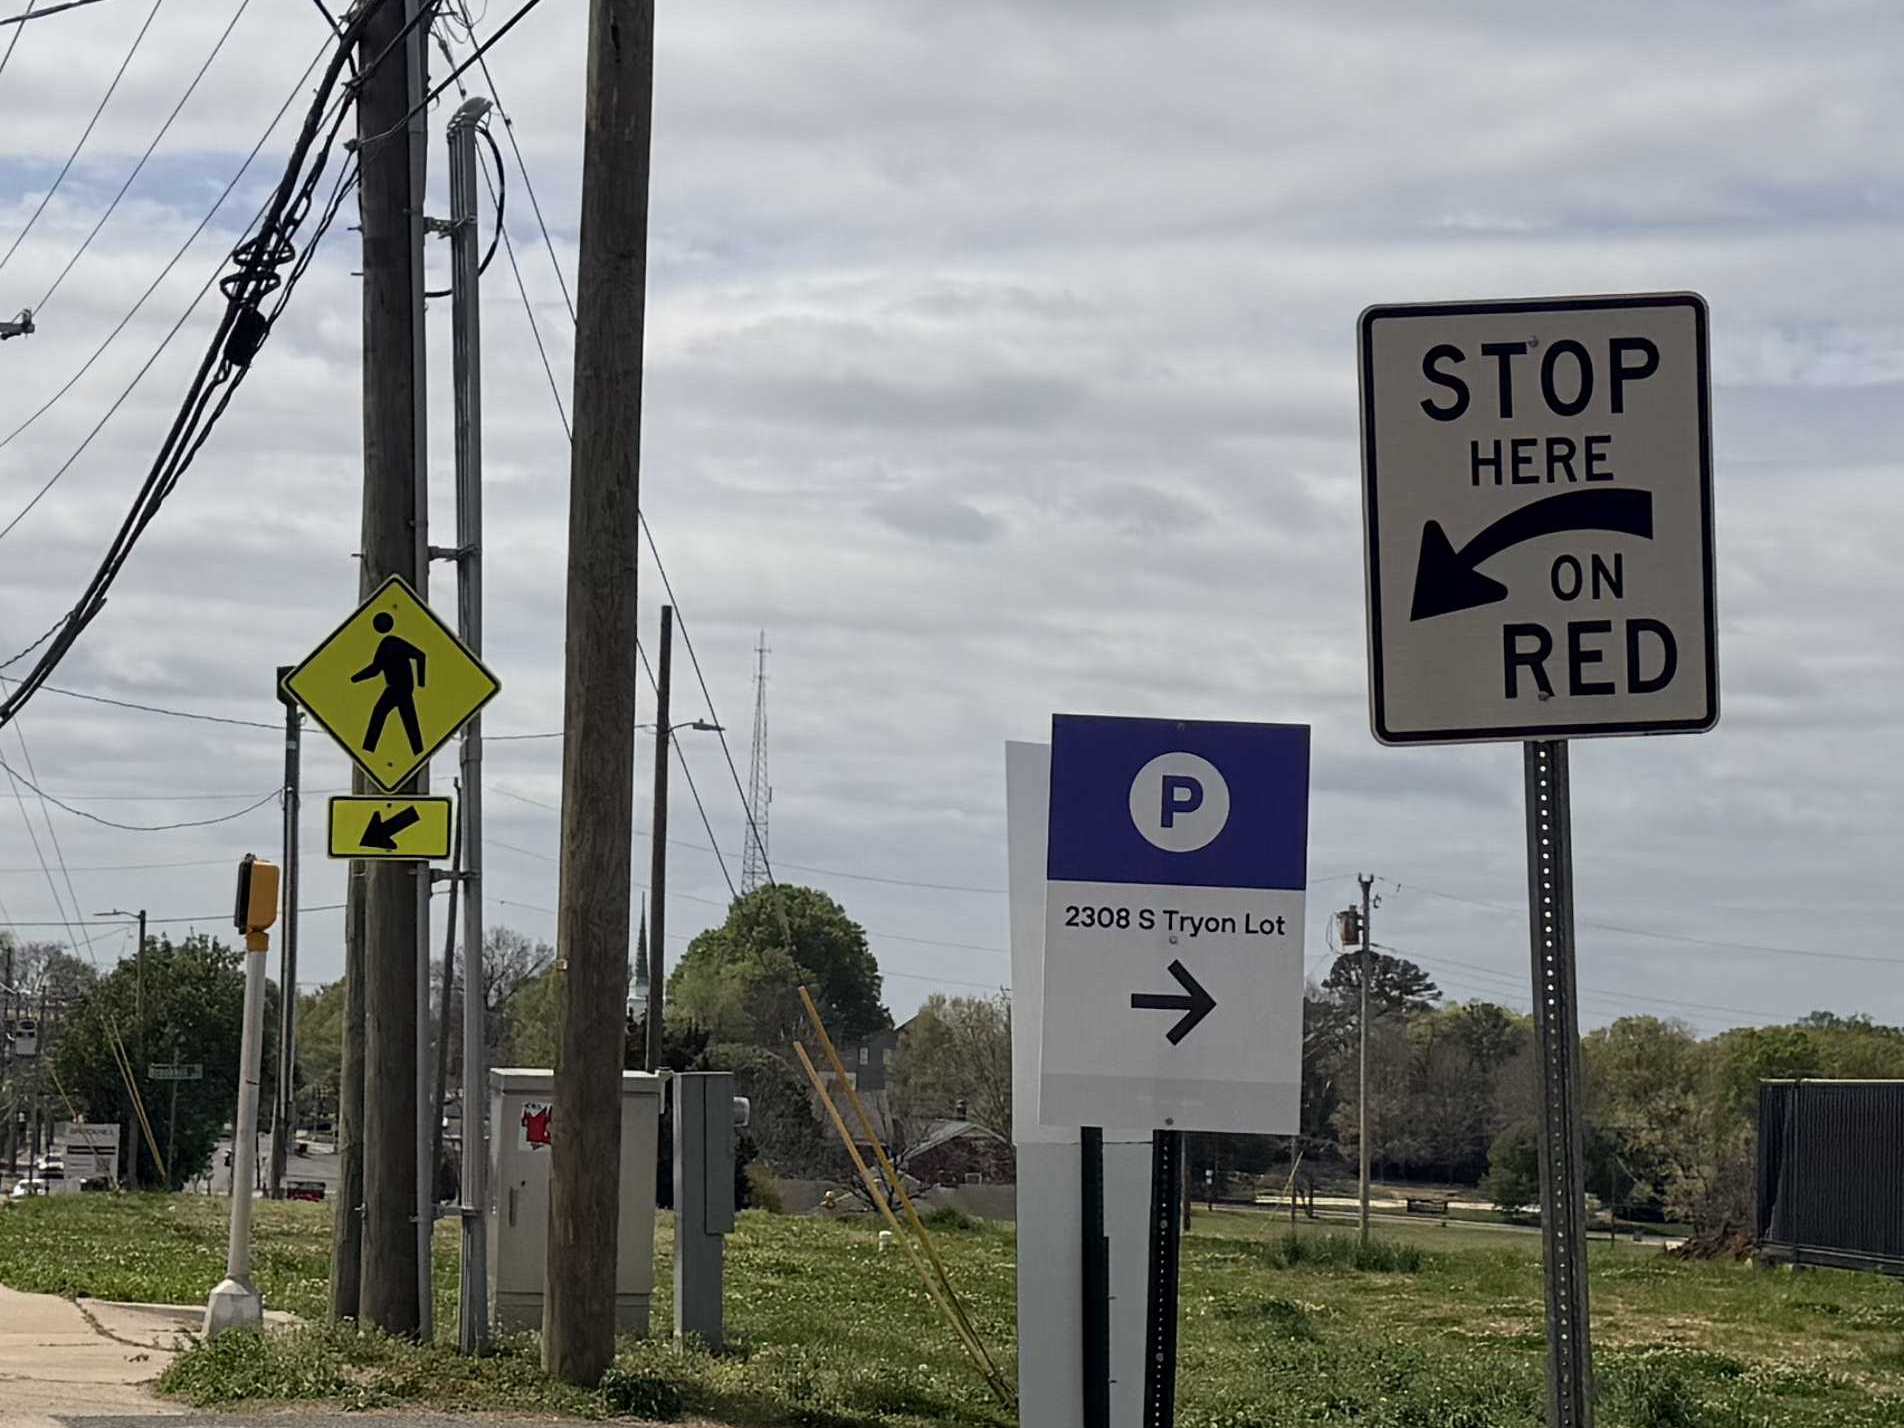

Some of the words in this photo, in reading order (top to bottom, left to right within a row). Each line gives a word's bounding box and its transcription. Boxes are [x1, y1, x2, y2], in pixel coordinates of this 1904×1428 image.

[1419, 337, 1660, 422] STOP
[1470, 435, 1614, 486] HERE
[1550, 553, 1625, 601] ON
[1502, 618, 1678, 699] RED
[1160, 775, 1204, 828] P
[1065, 905, 1130, 929] 2308
[1139, 909, 1155, 930] S
[1163, 910, 1236, 937] Tryon
[1245, 913, 1286, 935] Lot
